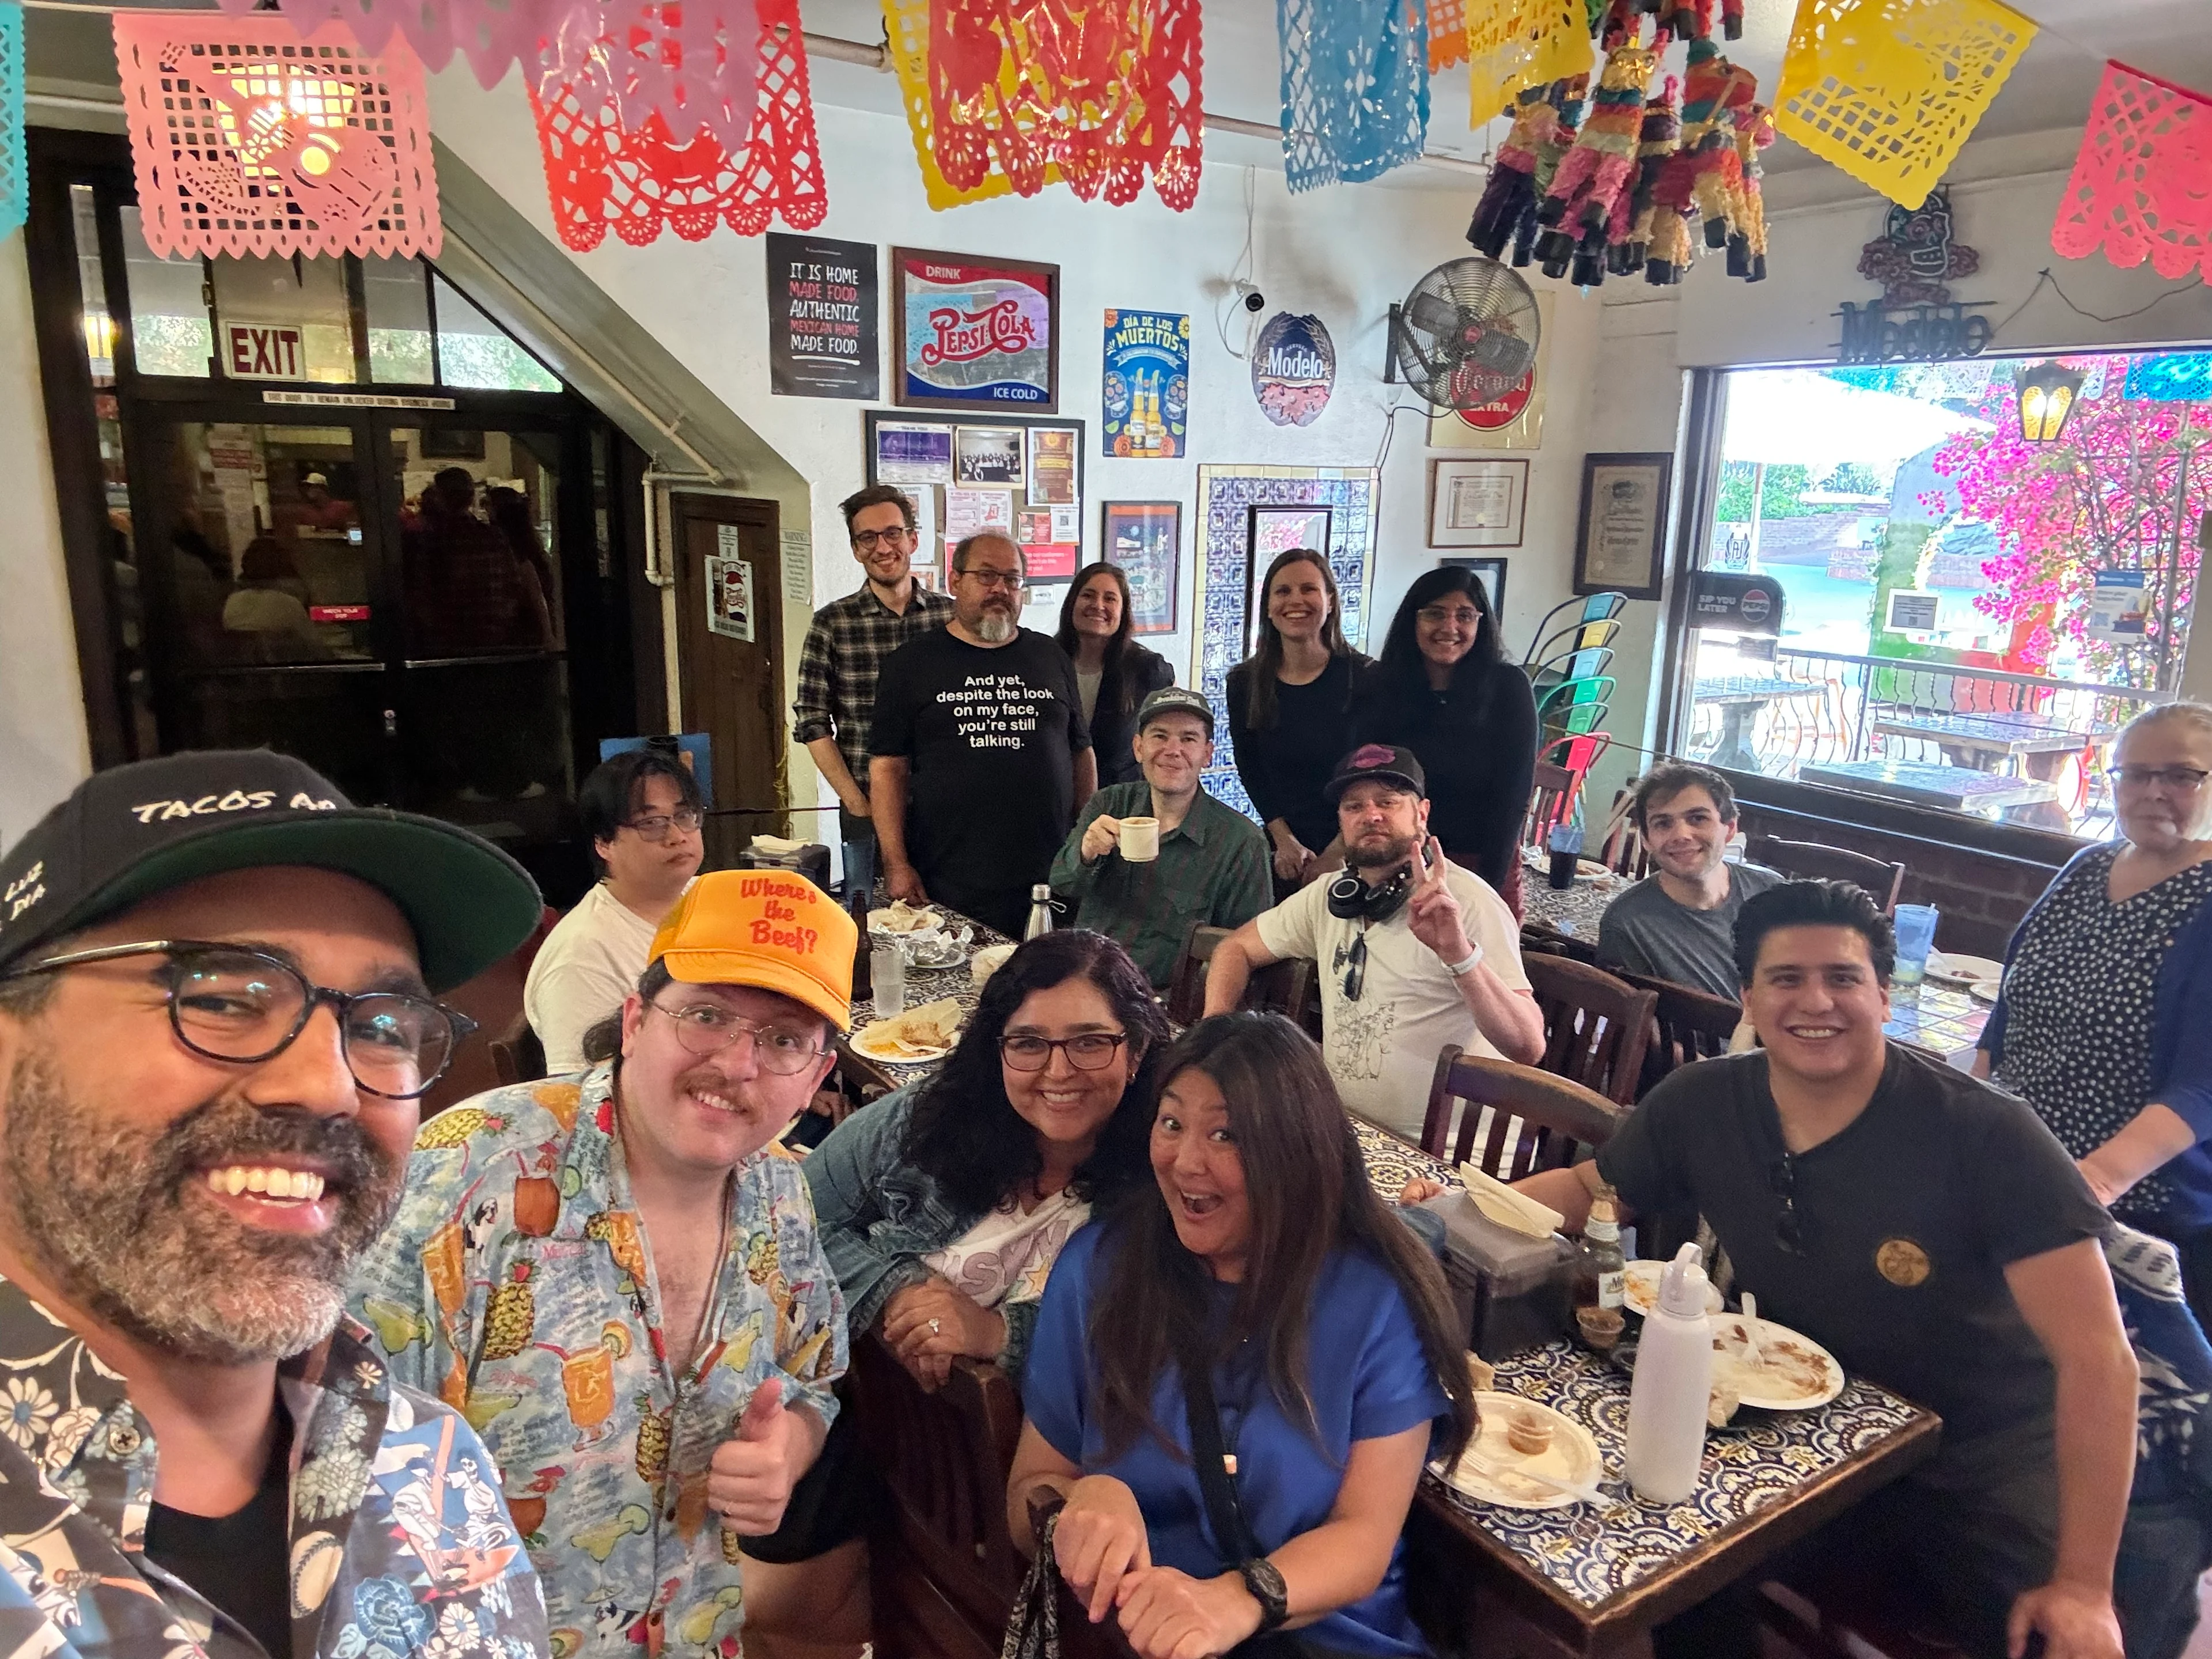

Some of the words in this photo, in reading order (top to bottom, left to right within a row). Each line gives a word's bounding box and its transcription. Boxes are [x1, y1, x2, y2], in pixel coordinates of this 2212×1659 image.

[790, 262, 805, 279] IT
[808, 264, 822, 281] IS
[825, 265, 859, 285] HOME
[926, 265, 961, 279] DRINK
[789, 281, 822, 299] MADE
[790, 299, 860, 323] AUTHENTIC
[790, 320, 832, 335] MEXICAN
[835, 324, 860, 338] HOME
[1141, 316, 1153, 328] DE
[1156, 318, 1173, 332] LOS
[791, 334, 824, 351] MADE
[828, 338, 859, 354] FOOD.
[1115, 328, 1180, 352] MUERTOS
[230, 327, 298, 374] EXIT
[1268, 347, 1324, 378] Modelo
[994, 388, 1009, 398] ICE
[1010, 389, 1038, 400] COLD
[1698, 604, 1728, 612] LATER
[965, 674, 994, 687] And
[998, 675, 1025, 688] yet,
[936, 689, 993, 703] despite
[996, 688, 1020, 700] the
[1024, 688, 1054, 699] look
[953, 706, 973, 717] on
[977, 706, 999, 718] my
[1002, 703, 1039, 717] face,
[1010, 718, 1036, 730] still
[969, 734, 1025, 749] talking.
[131, 790, 278, 823] TACOS
[764, 900, 796, 922] the
[749, 920, 818, 955] Beef?
